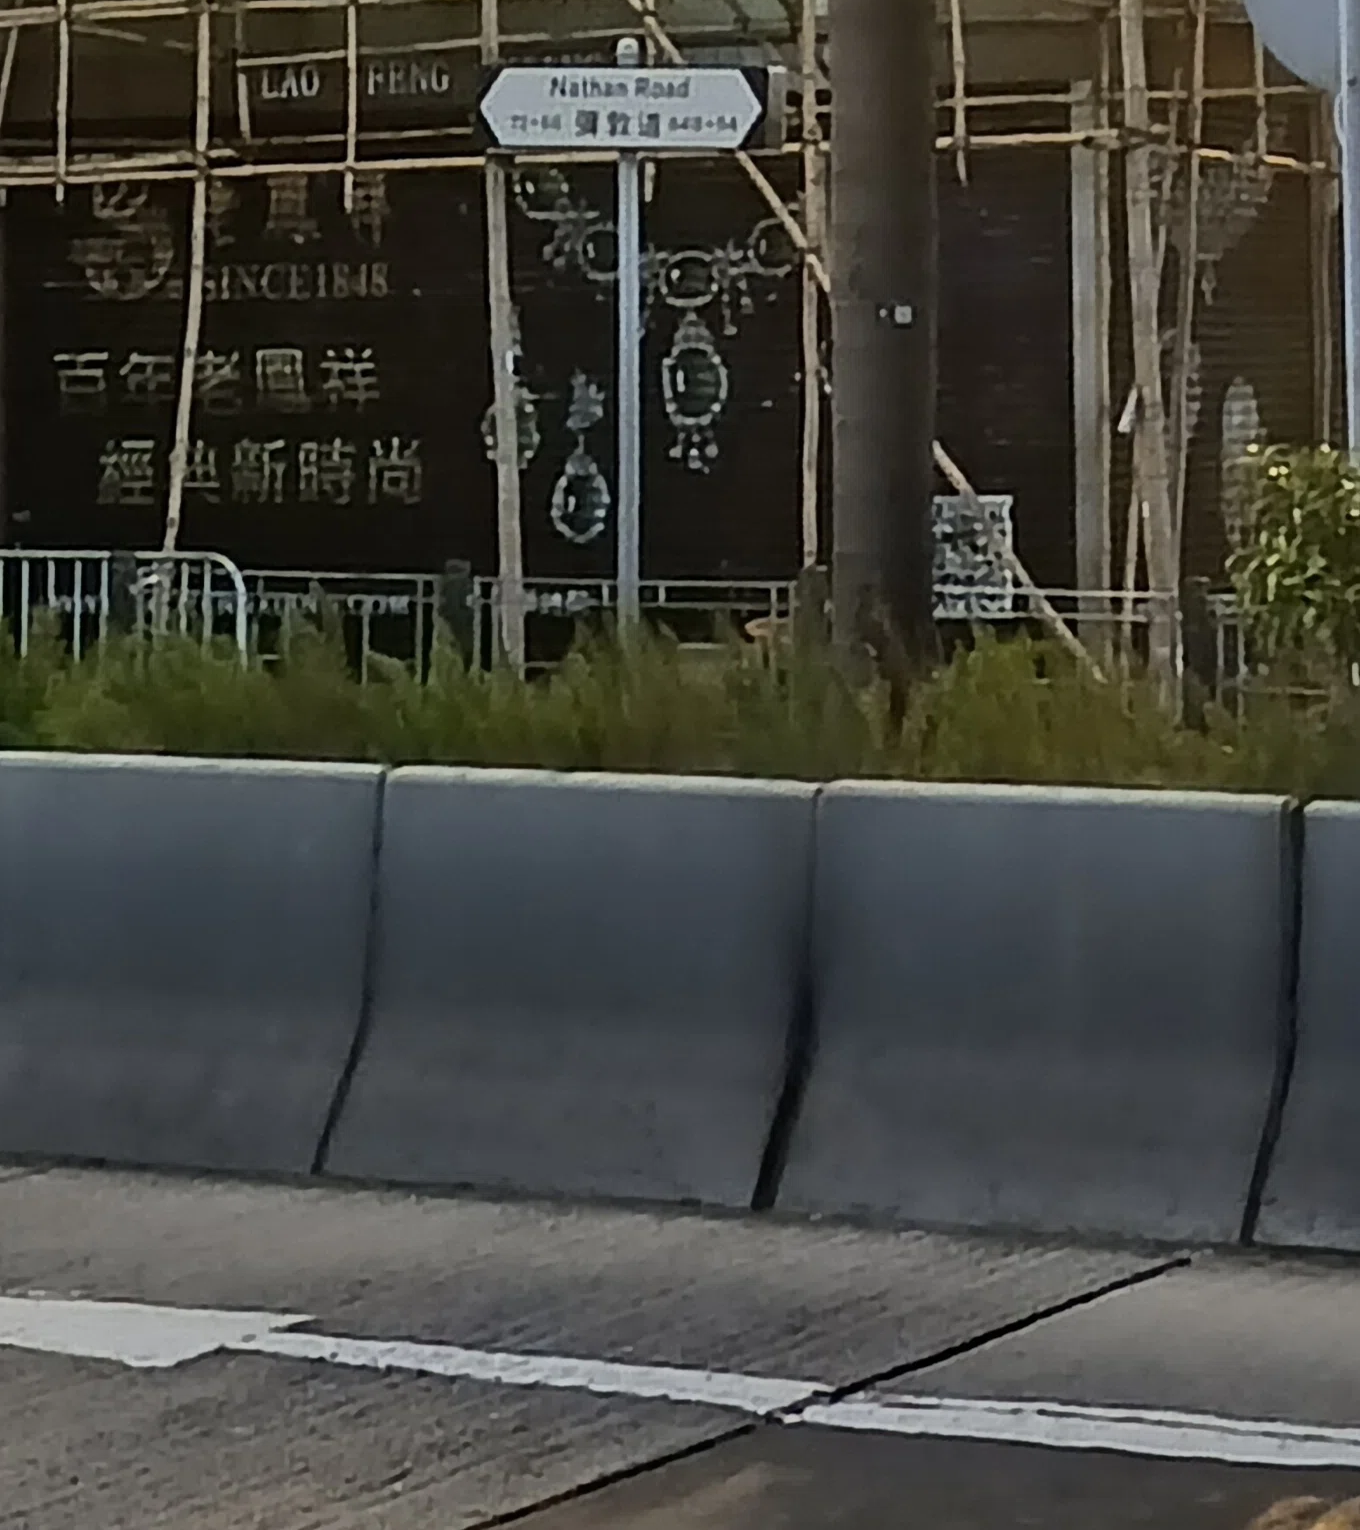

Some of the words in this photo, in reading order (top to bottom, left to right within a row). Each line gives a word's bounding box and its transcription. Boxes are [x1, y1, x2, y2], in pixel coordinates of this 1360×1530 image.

[261, 63, 320, 99] LAO
[549, 74, 629, 99] Nathan
[634, 75, 691, 99] Road
